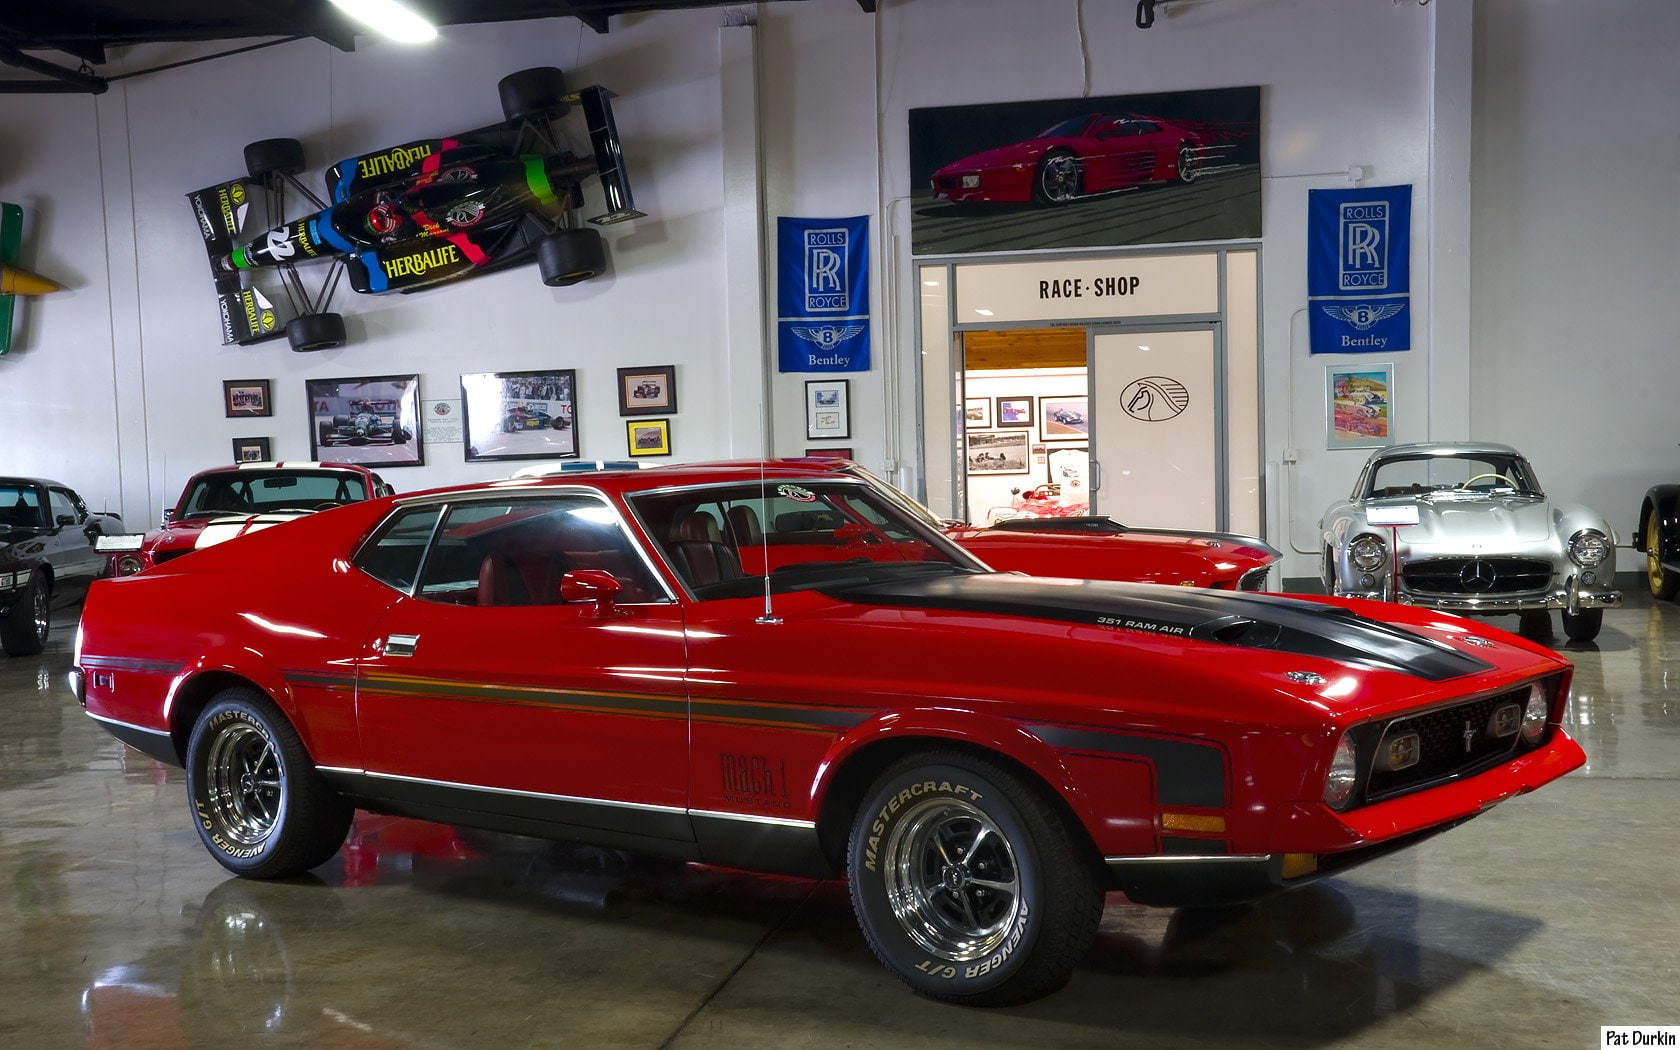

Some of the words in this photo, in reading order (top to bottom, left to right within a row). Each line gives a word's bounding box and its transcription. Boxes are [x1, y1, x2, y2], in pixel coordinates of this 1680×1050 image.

[358, 144, 432, 179] HERBALIFE
[194, 194, 211, 239] YOKOHAMA
[218, 188, 235, 233] HERBALIFE
[1346, 206, 1383, 219] ROLLS
[810, 233, 844, 245] ROLLS
[384, 244, 460, 279] HERBALIFE
[1039, 278, 1083, 299] RACE
[1094, 276, 1140, 297] SHOP
[1343, 273, 1384, 286] ROYCE
[809, 296, 846, 308] ROYCE
[220, 297, 235, 343] YOKOHAMA
[243, 290, 260, 335] HERBALIFE
[1357, 310, 1369, 323] B
[823, 331, 833, 343] B
[1341, 334, 1388, 348] Bentley
[808, 354, 850, 368] Bentley
[1097, 616, 1121, 625] 351
[1125, 620, 1157, 631] RAM
[1160, 625, 1184, 634] AIR
[724, 795, 791, 808] MUSTANG
[865, 780, 983, 872] MASTERCRAFT
[211, 833, 266, 858] AVENGER
[964, 896, 1030, 979] AVENGER
[914, 960, 956, 979] G/T
